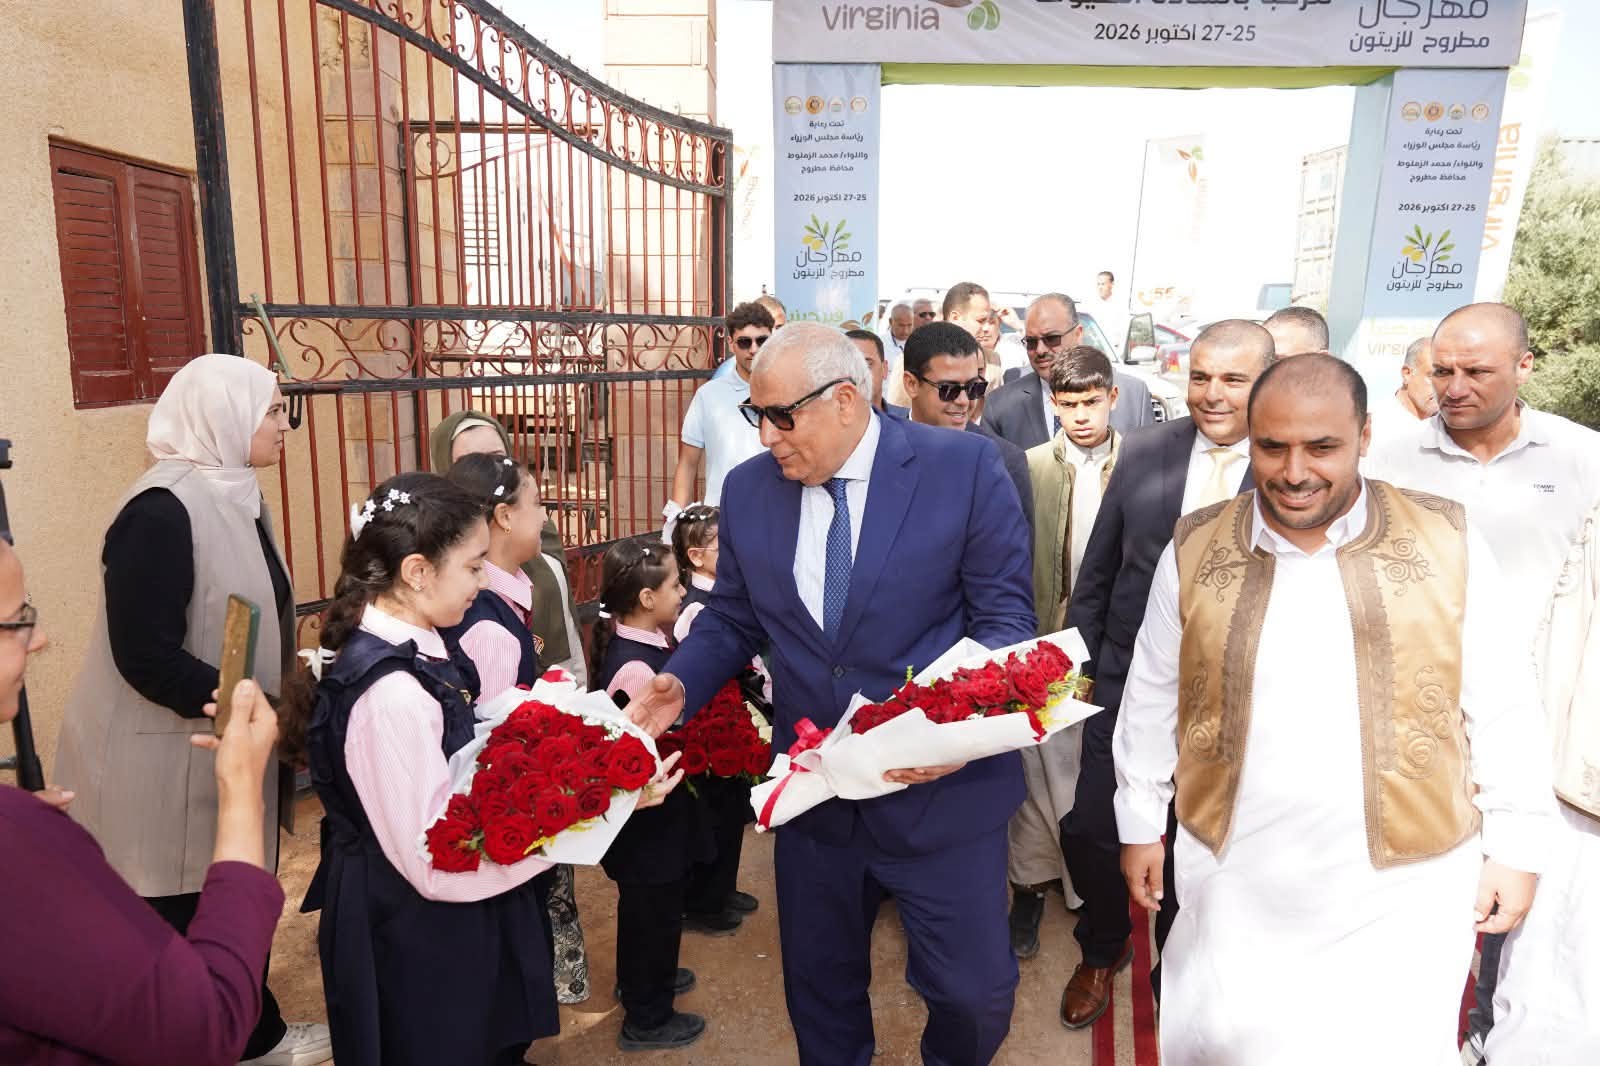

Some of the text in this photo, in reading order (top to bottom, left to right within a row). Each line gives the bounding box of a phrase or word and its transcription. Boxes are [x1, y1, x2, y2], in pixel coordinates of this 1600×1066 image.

[822, 4, 940, 31] Virginia
[1094, 23, 1141, 40] 2026
[1145, 24, 1196, 44] اكتوبر
[1349, 30, 1490, 54] مطروح للزيتون
[1446, 127, 1464, 135] تحت
[1428, 141, 1455, 151] مجلس
[793, 193, 815, 202] 2026
[1398, 203, 1421, 212] 2026
[796, 245, 862, 268] مهرجان
[831, 267, 865, 280] مطروح
[1391, 256, 1463, 279] مهرجان
[1426, 279, 1464, 292] مطروح
